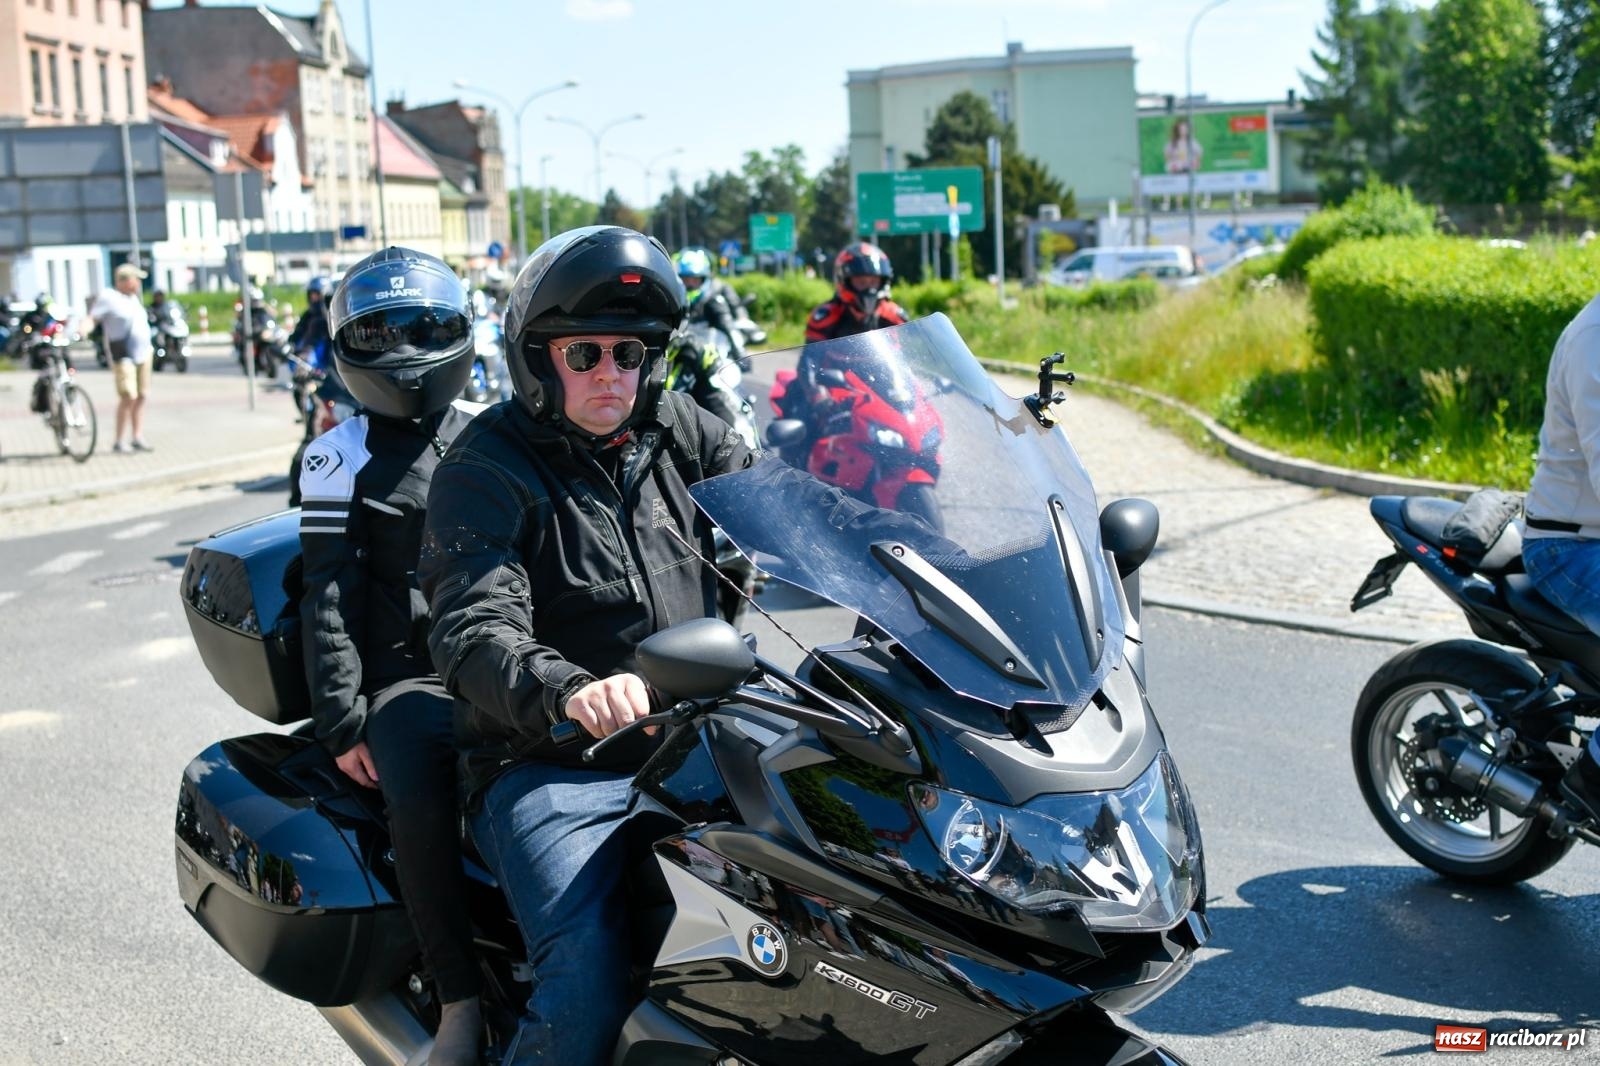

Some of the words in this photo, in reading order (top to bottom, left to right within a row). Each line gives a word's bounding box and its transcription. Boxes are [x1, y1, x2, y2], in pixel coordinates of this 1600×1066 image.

[375, 287, 423, 300] SHARK
[751, 927, 783, 950] BMW
[886, 989, 939, 1020] GT
